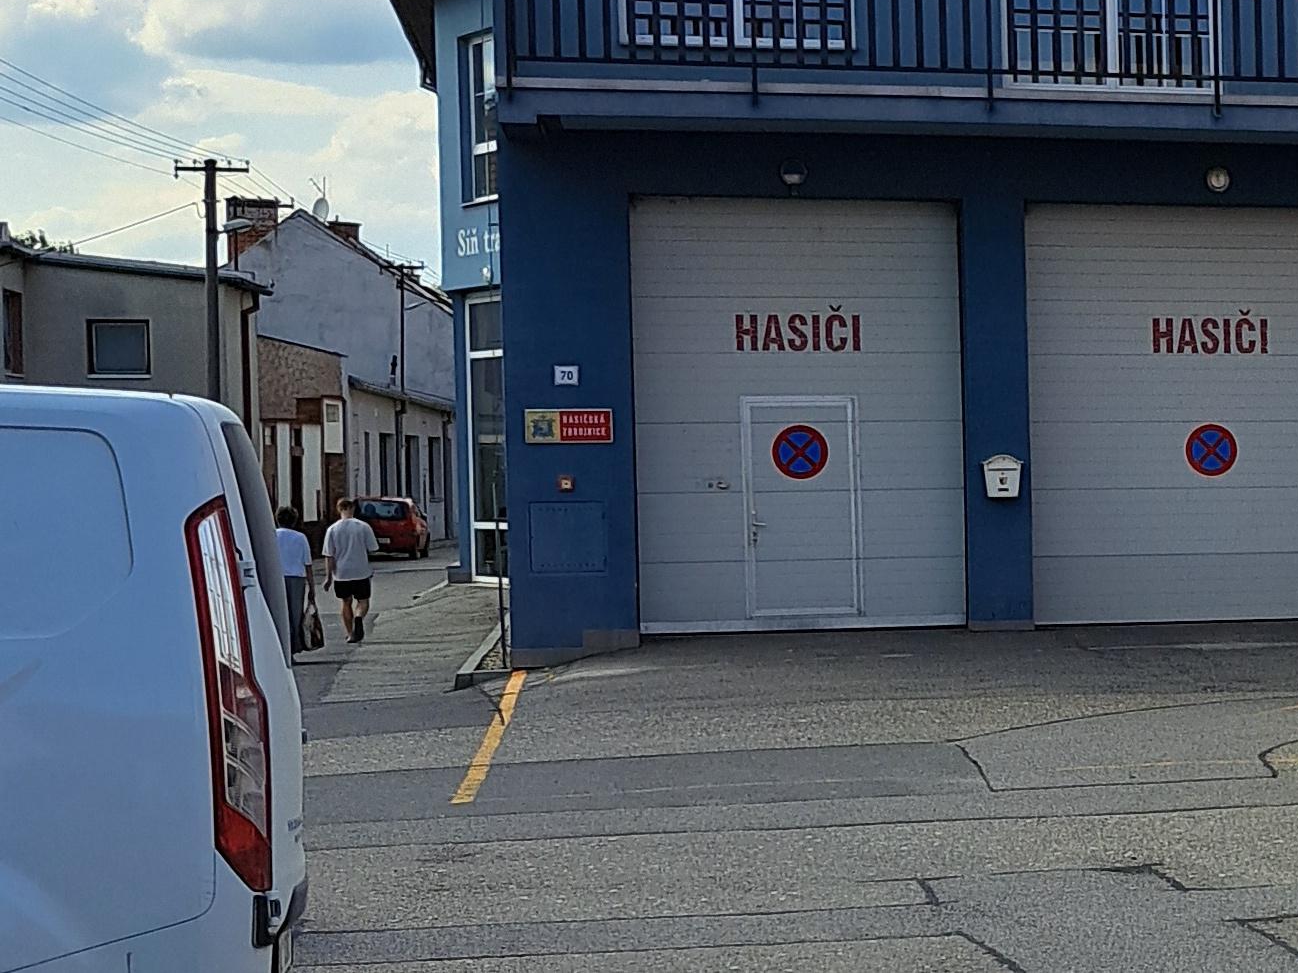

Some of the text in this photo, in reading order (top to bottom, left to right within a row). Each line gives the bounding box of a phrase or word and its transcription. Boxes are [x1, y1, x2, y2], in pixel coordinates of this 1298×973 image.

[457, 227, 479, 257] Síň
[735, 304, 862, 352] HASIČI
[1152, 309, 1269, 355] HASIČI
[560, 370, 574, 381] 70
